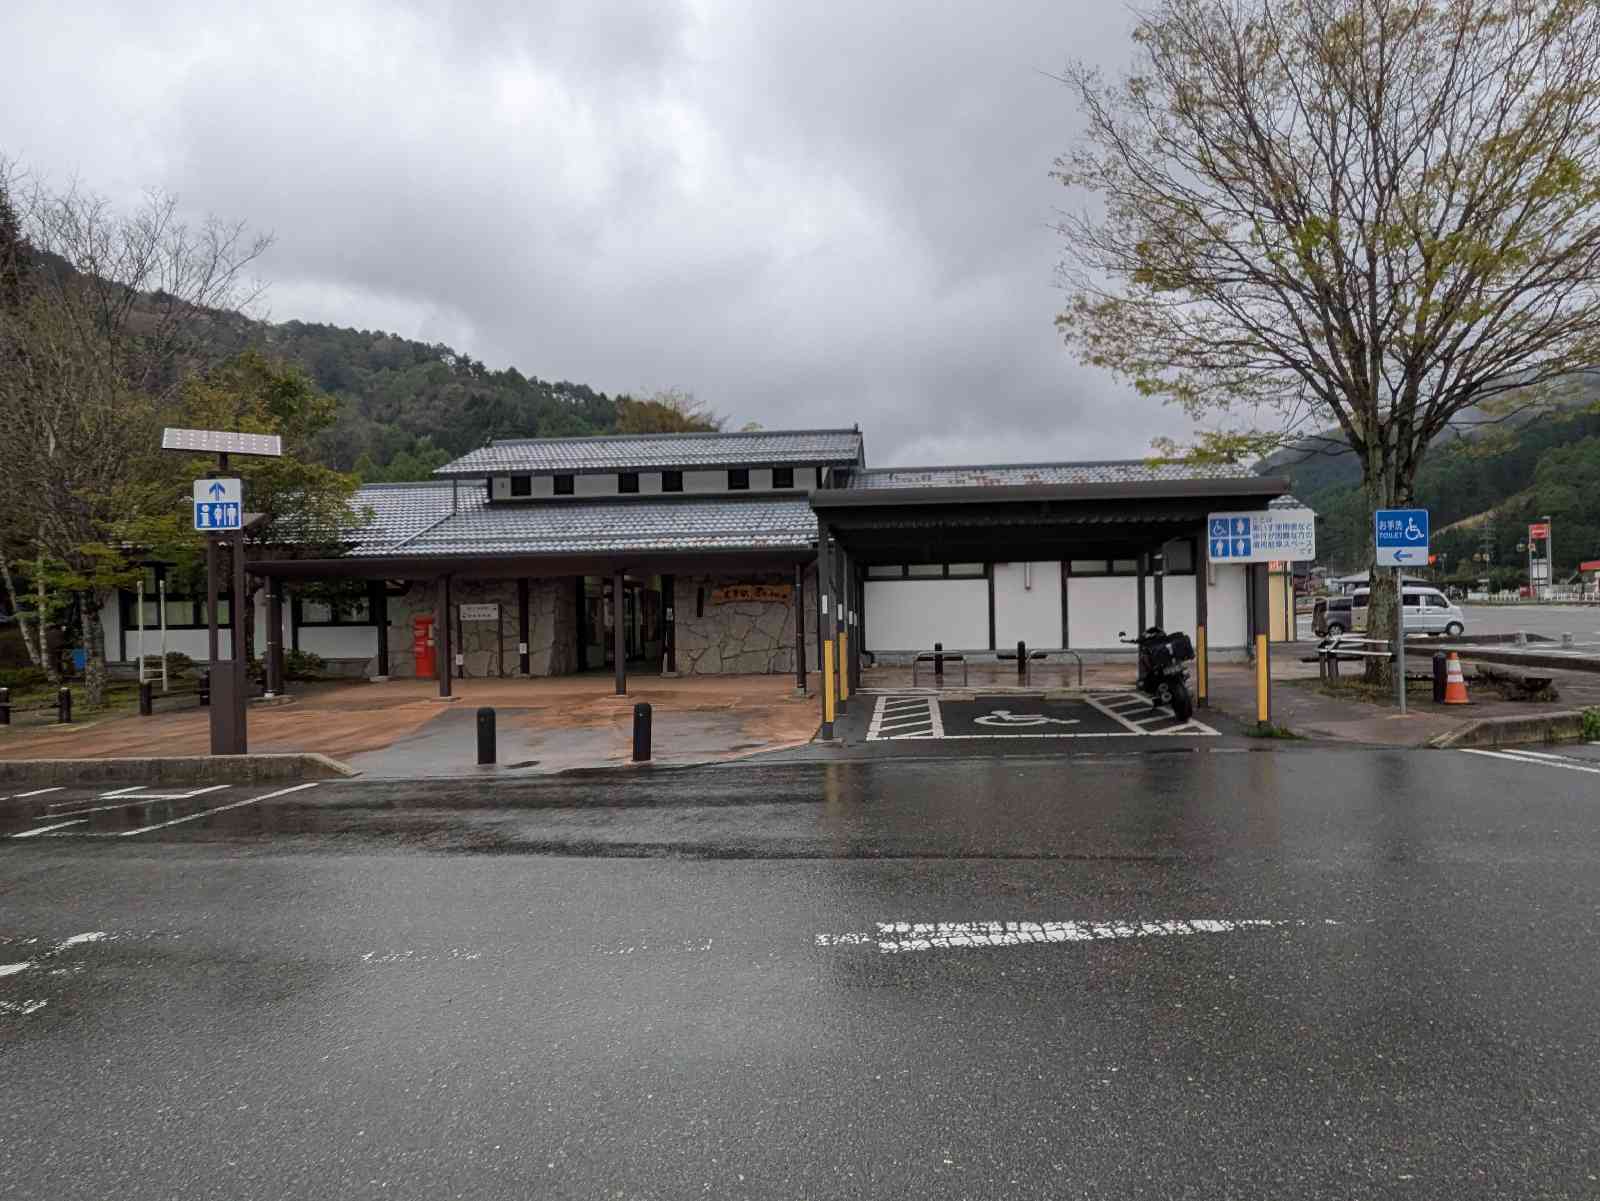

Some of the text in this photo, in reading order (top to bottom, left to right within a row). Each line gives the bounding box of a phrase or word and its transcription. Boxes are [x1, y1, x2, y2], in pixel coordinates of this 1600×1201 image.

[1379, 519, 1403, 531] お手洗
[1379, 531, 1402, 539] TOILET
